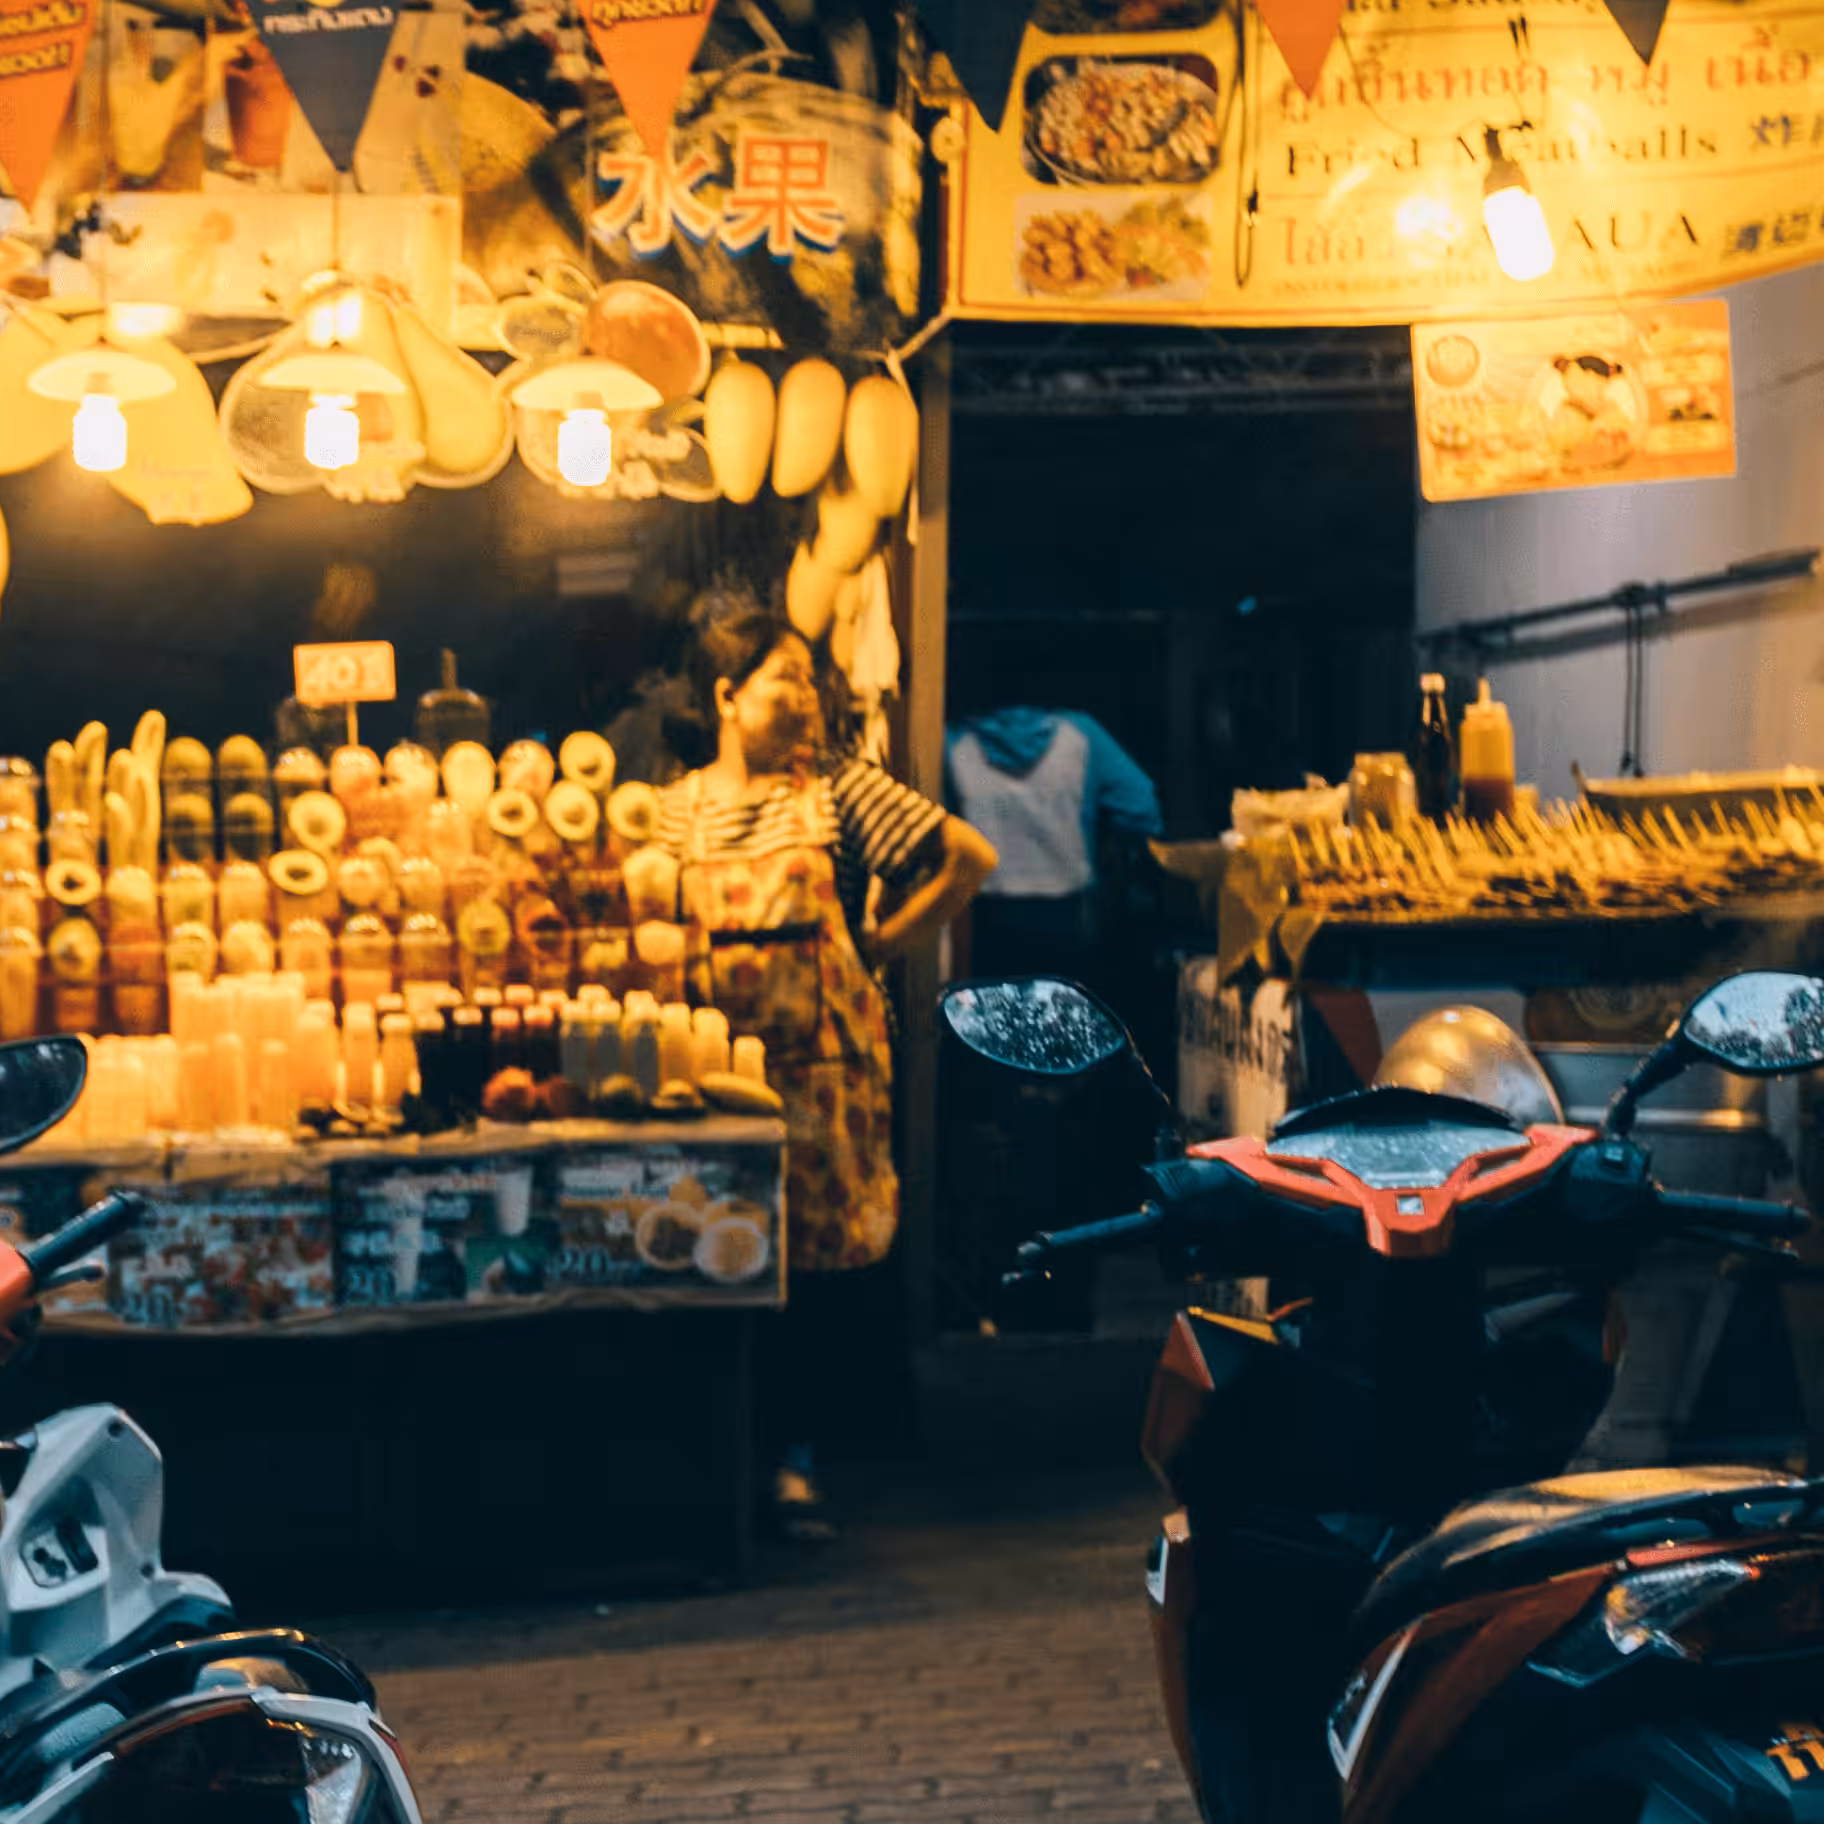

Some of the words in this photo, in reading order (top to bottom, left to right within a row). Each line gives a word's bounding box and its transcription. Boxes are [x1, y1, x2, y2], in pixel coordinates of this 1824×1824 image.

[263, 5, 394, 35] กระทิงแดง
[591, 134, 848, 264] 水果
